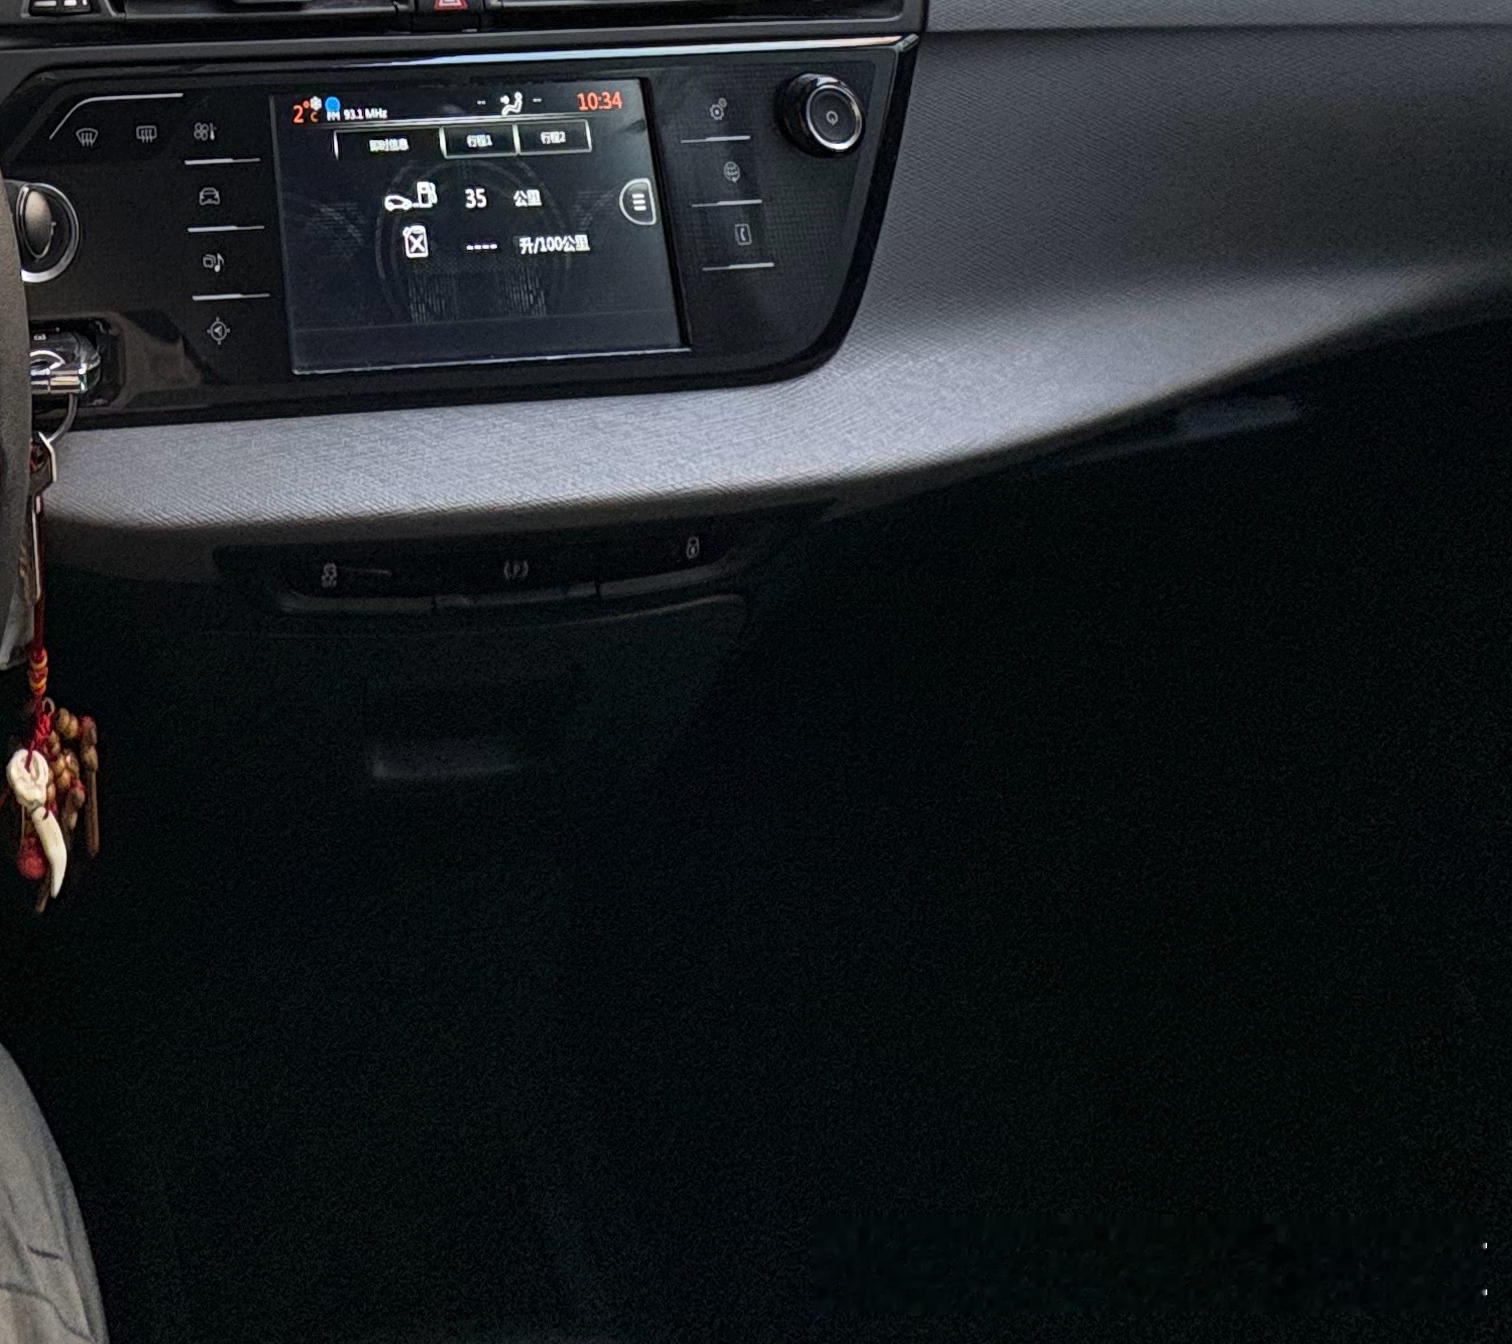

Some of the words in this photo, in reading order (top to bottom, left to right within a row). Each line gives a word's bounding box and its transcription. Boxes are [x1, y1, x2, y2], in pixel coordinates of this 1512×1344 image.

[577, 91, 623, 112] 10:34
[343, 108, 364, 120] 93.1
[365, 107, 388, 119] MHz
[464, 188, 488, 209] 35
[513, 189, 542, 208] 公里
[519, 234, 591, 255] 升/100公里
